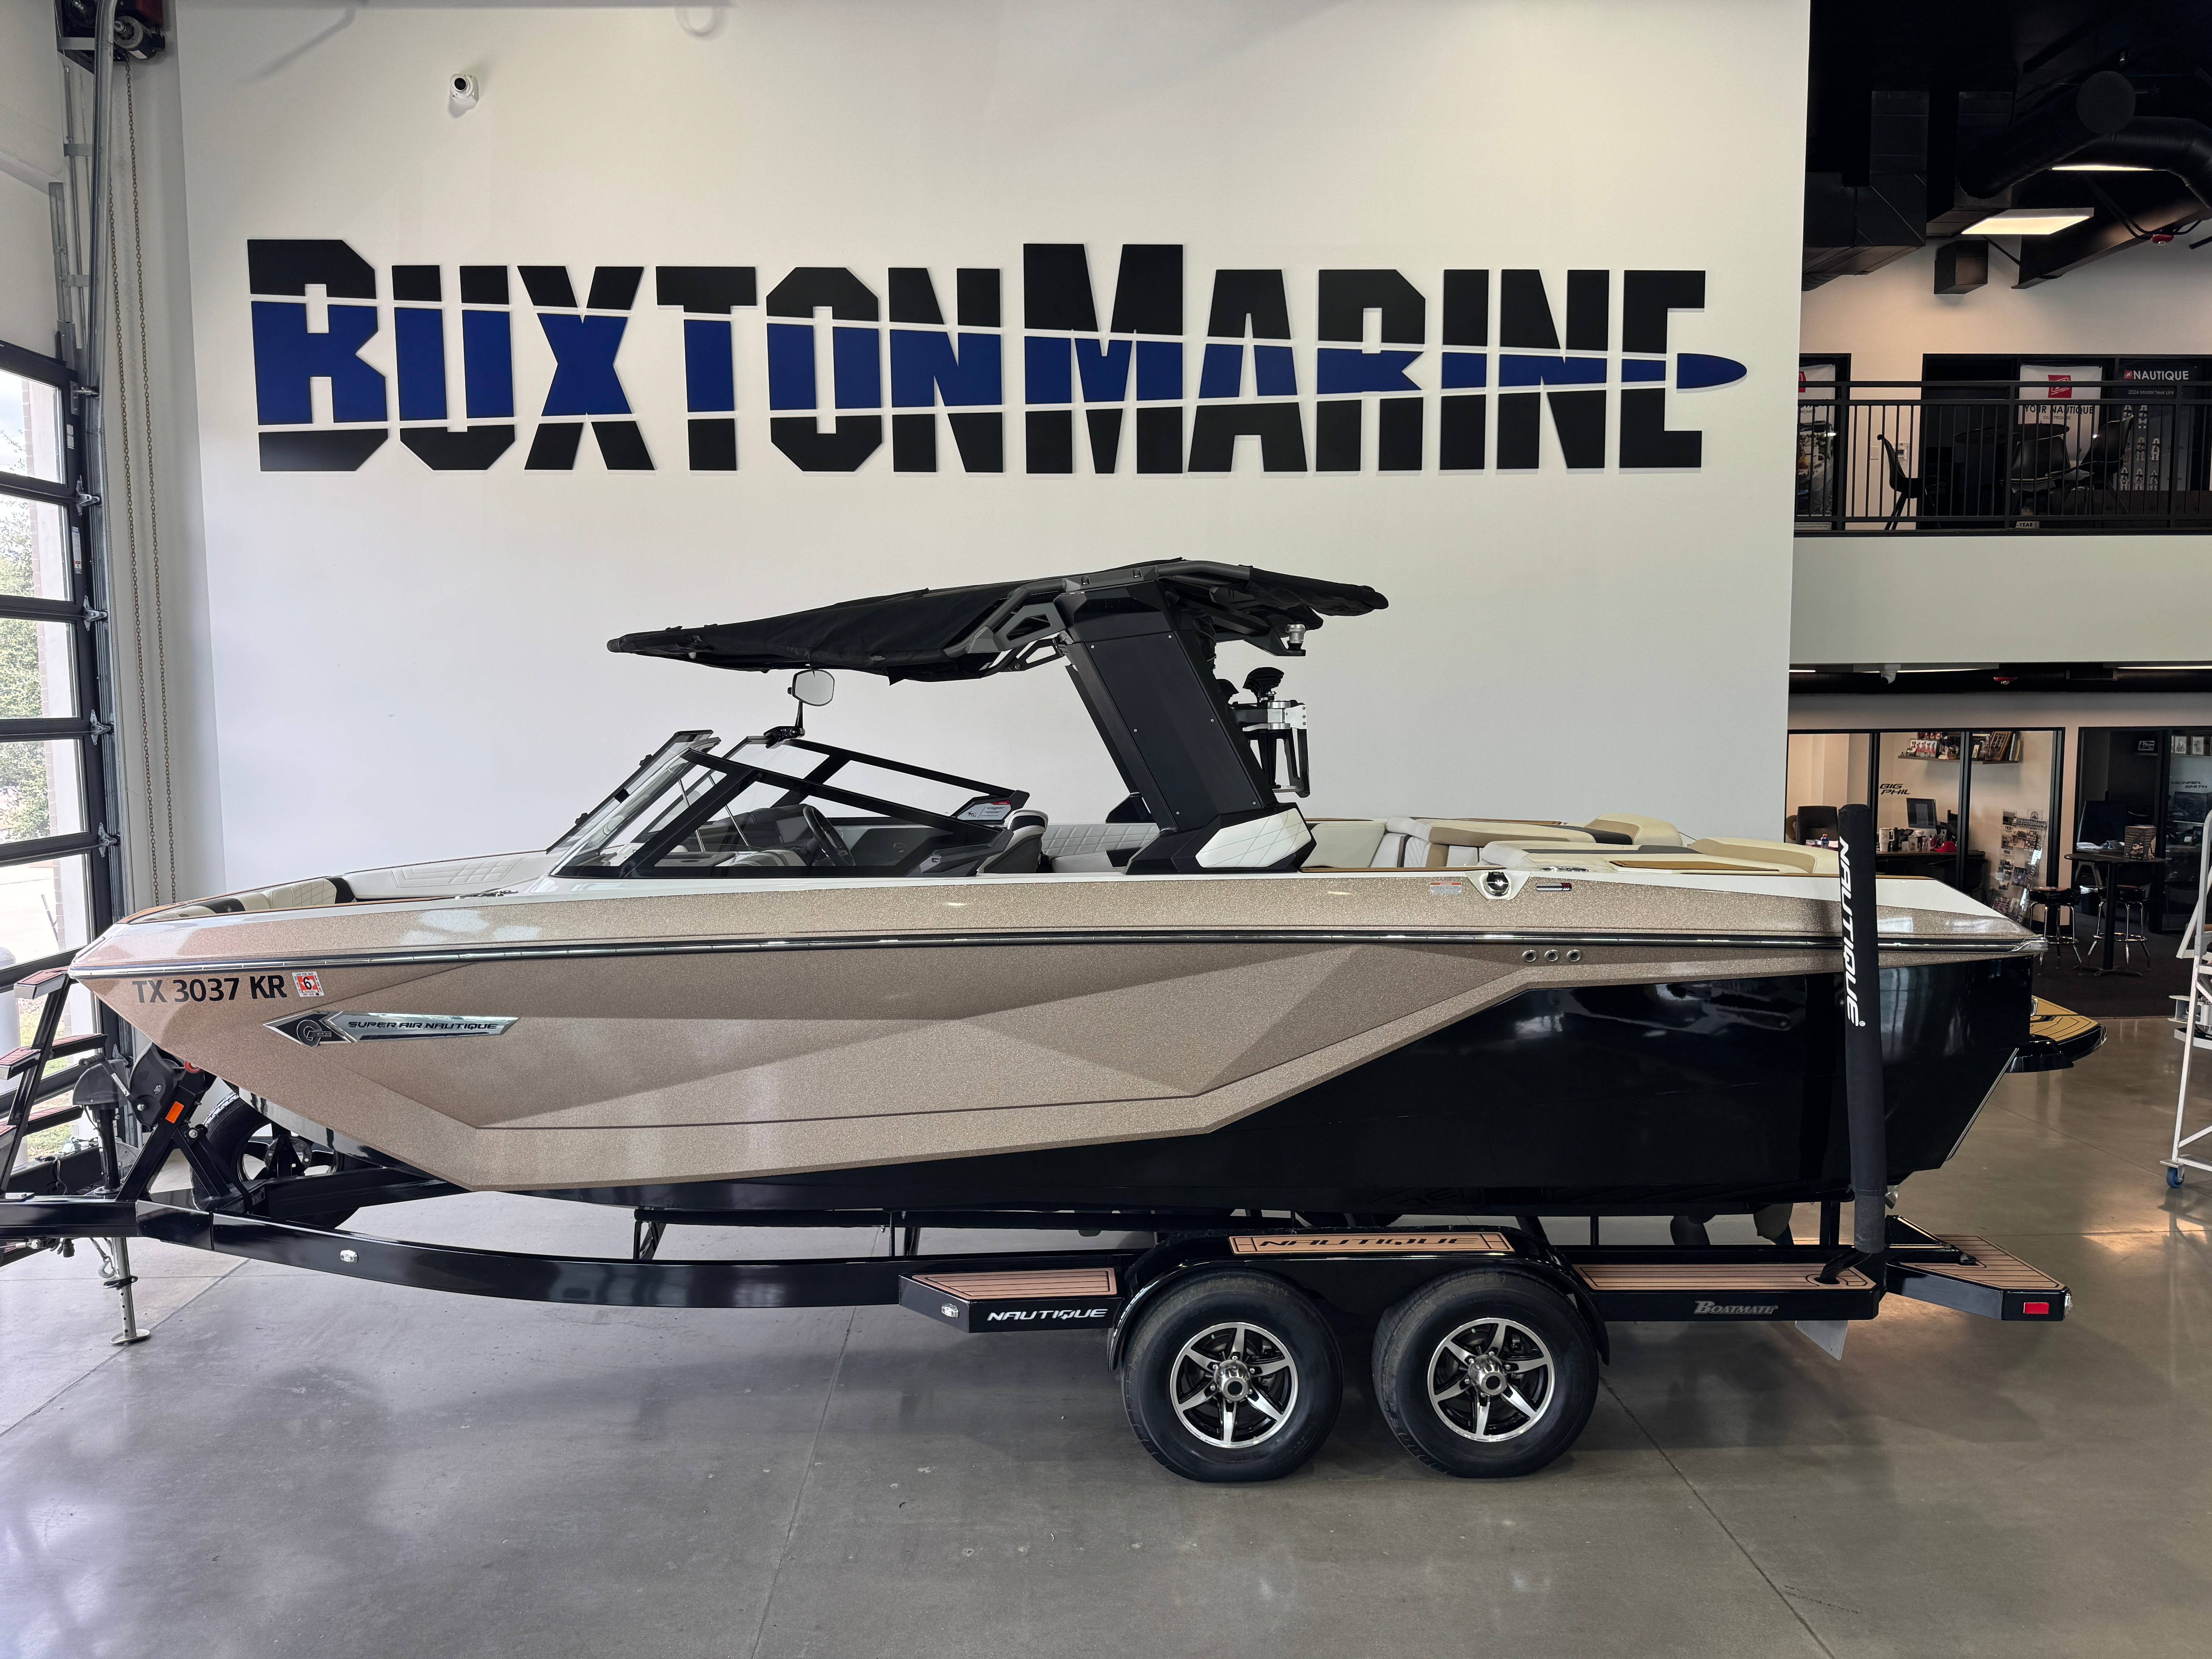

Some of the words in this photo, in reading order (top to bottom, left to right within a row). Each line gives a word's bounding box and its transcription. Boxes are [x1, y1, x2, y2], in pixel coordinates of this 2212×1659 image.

[2133, 370, 2189, 381] NAUTIQUE
[1839, 835, 1859, 1027] NAUTIQUE
[132, 980, 167, 1003] TX
[173, 977, 239, 1002] 3037
[249, 975, 287, 999] KR
[303, 976, 312, 990] 6
[1694, 1300, 1775, 1314] BOATMATE
[987, 1309, 1108, 1321] NAUTIQUE
